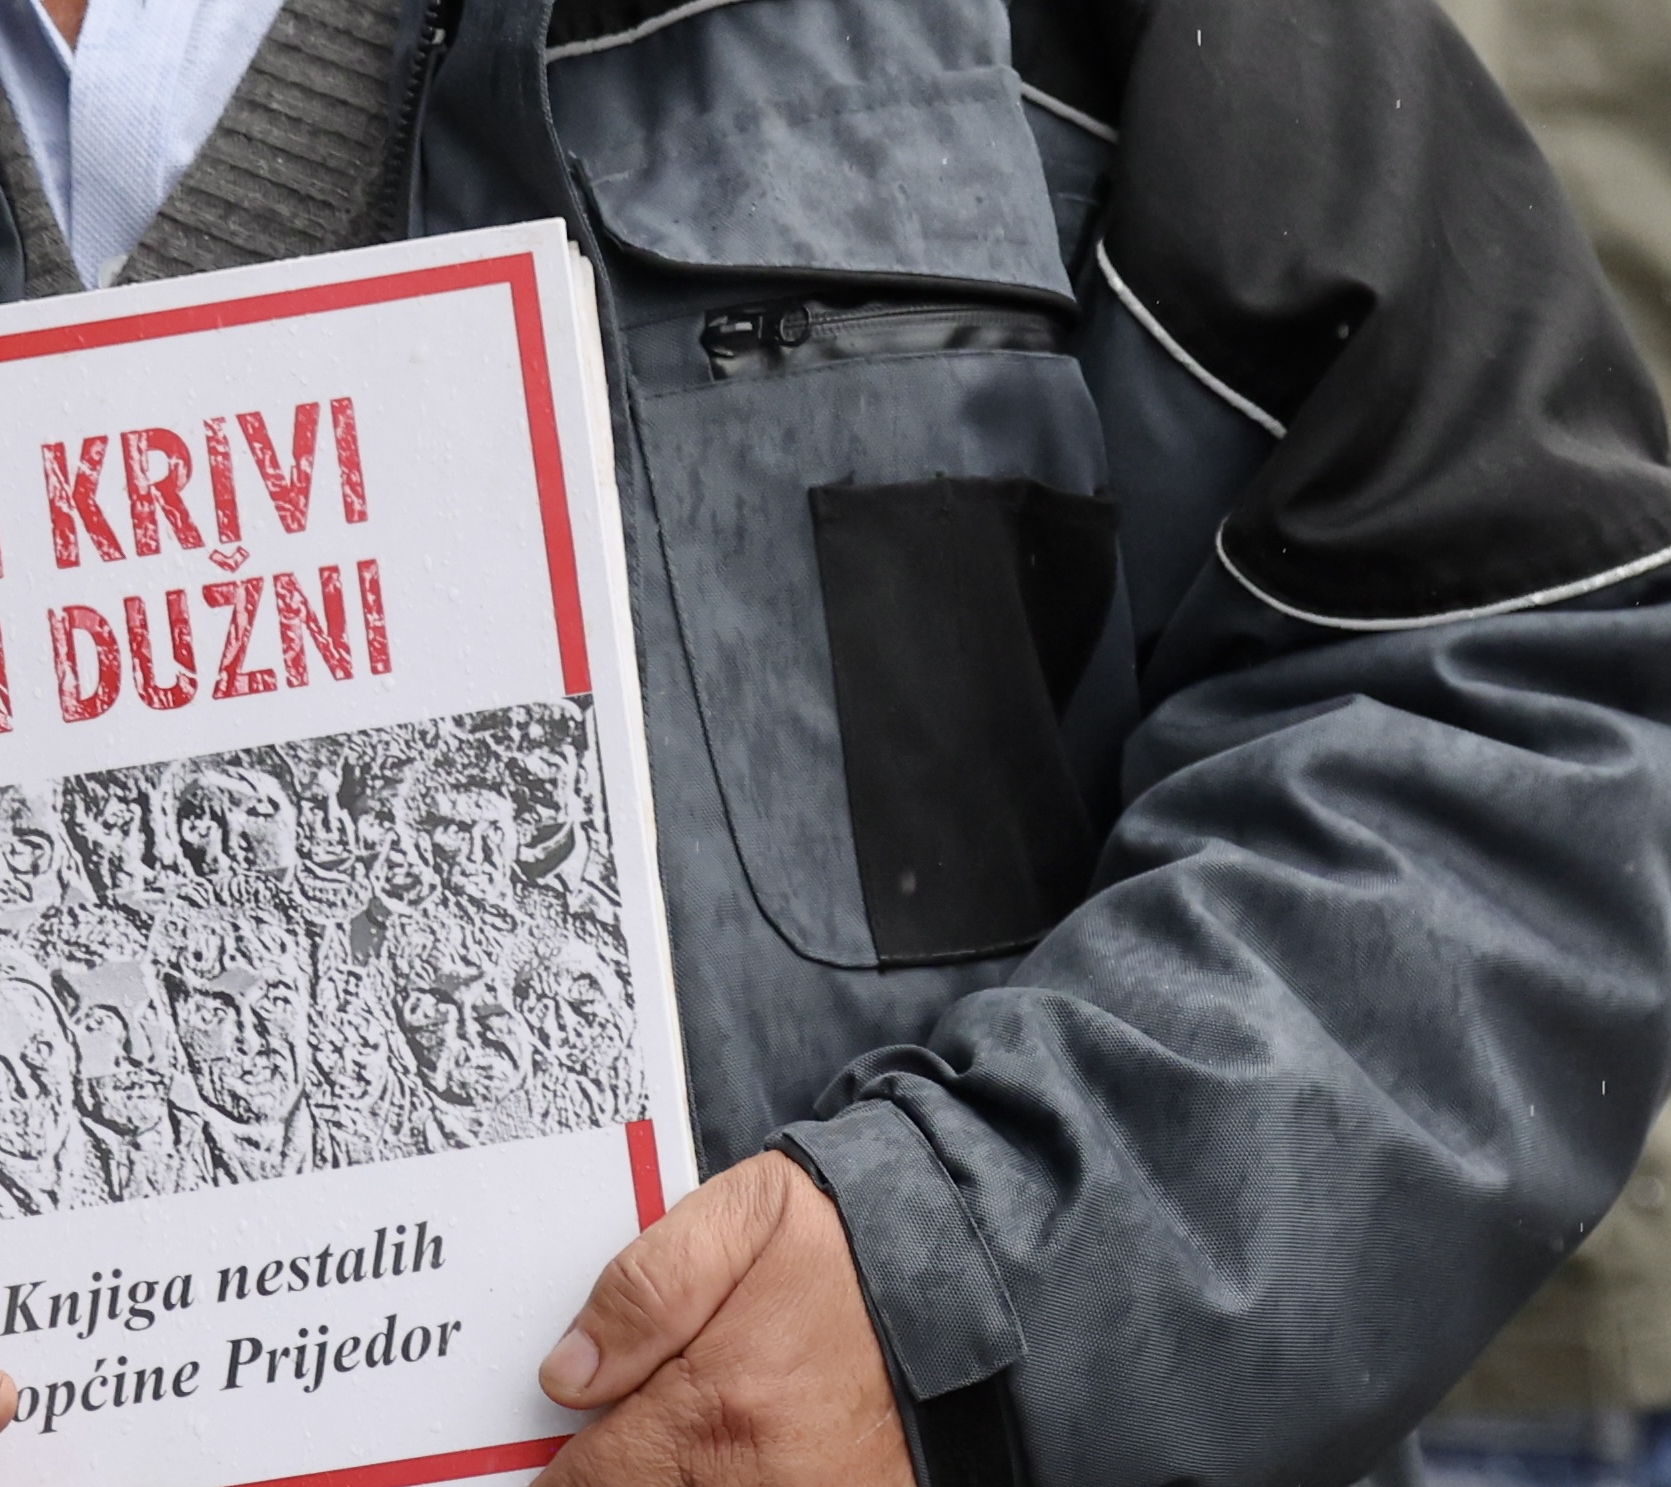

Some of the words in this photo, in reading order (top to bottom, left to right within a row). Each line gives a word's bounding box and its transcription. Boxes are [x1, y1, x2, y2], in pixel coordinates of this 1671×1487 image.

[41, 395, 370, 570] KRIVI
[47, 546, 394, 724] DUŽNI
[216, 1220, 447, 1304] nestalih
[12, 1354, 201, 1435] općine
[219, 1313, 463, 1394] Prijedor
